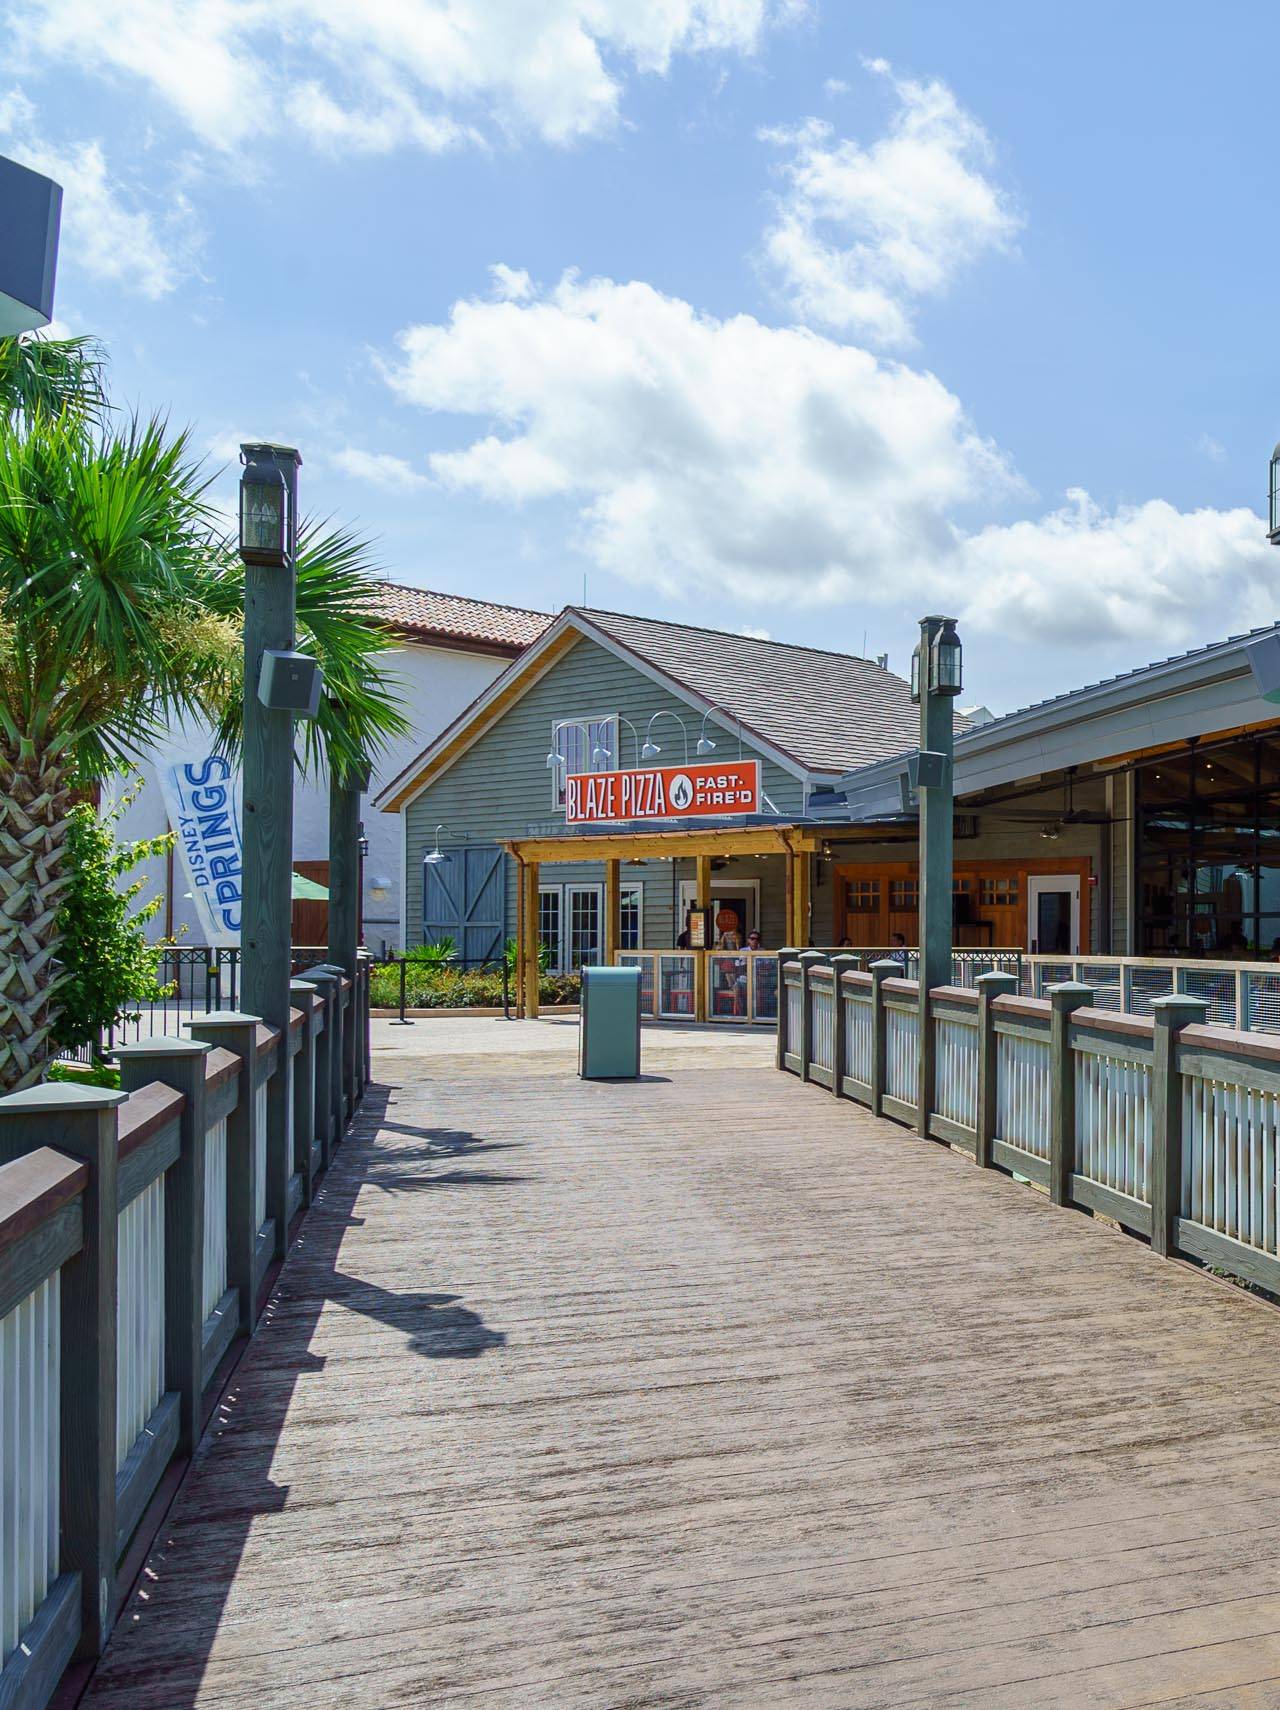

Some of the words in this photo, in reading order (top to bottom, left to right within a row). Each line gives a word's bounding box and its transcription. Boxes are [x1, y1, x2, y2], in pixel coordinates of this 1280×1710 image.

[568, 777, 616, 820] BLAZE
[621, 772, 666, 816] PIZZA
[696, 790, 752, 805] FIRE'D
[178, 815, 210, 887] DISNEY
